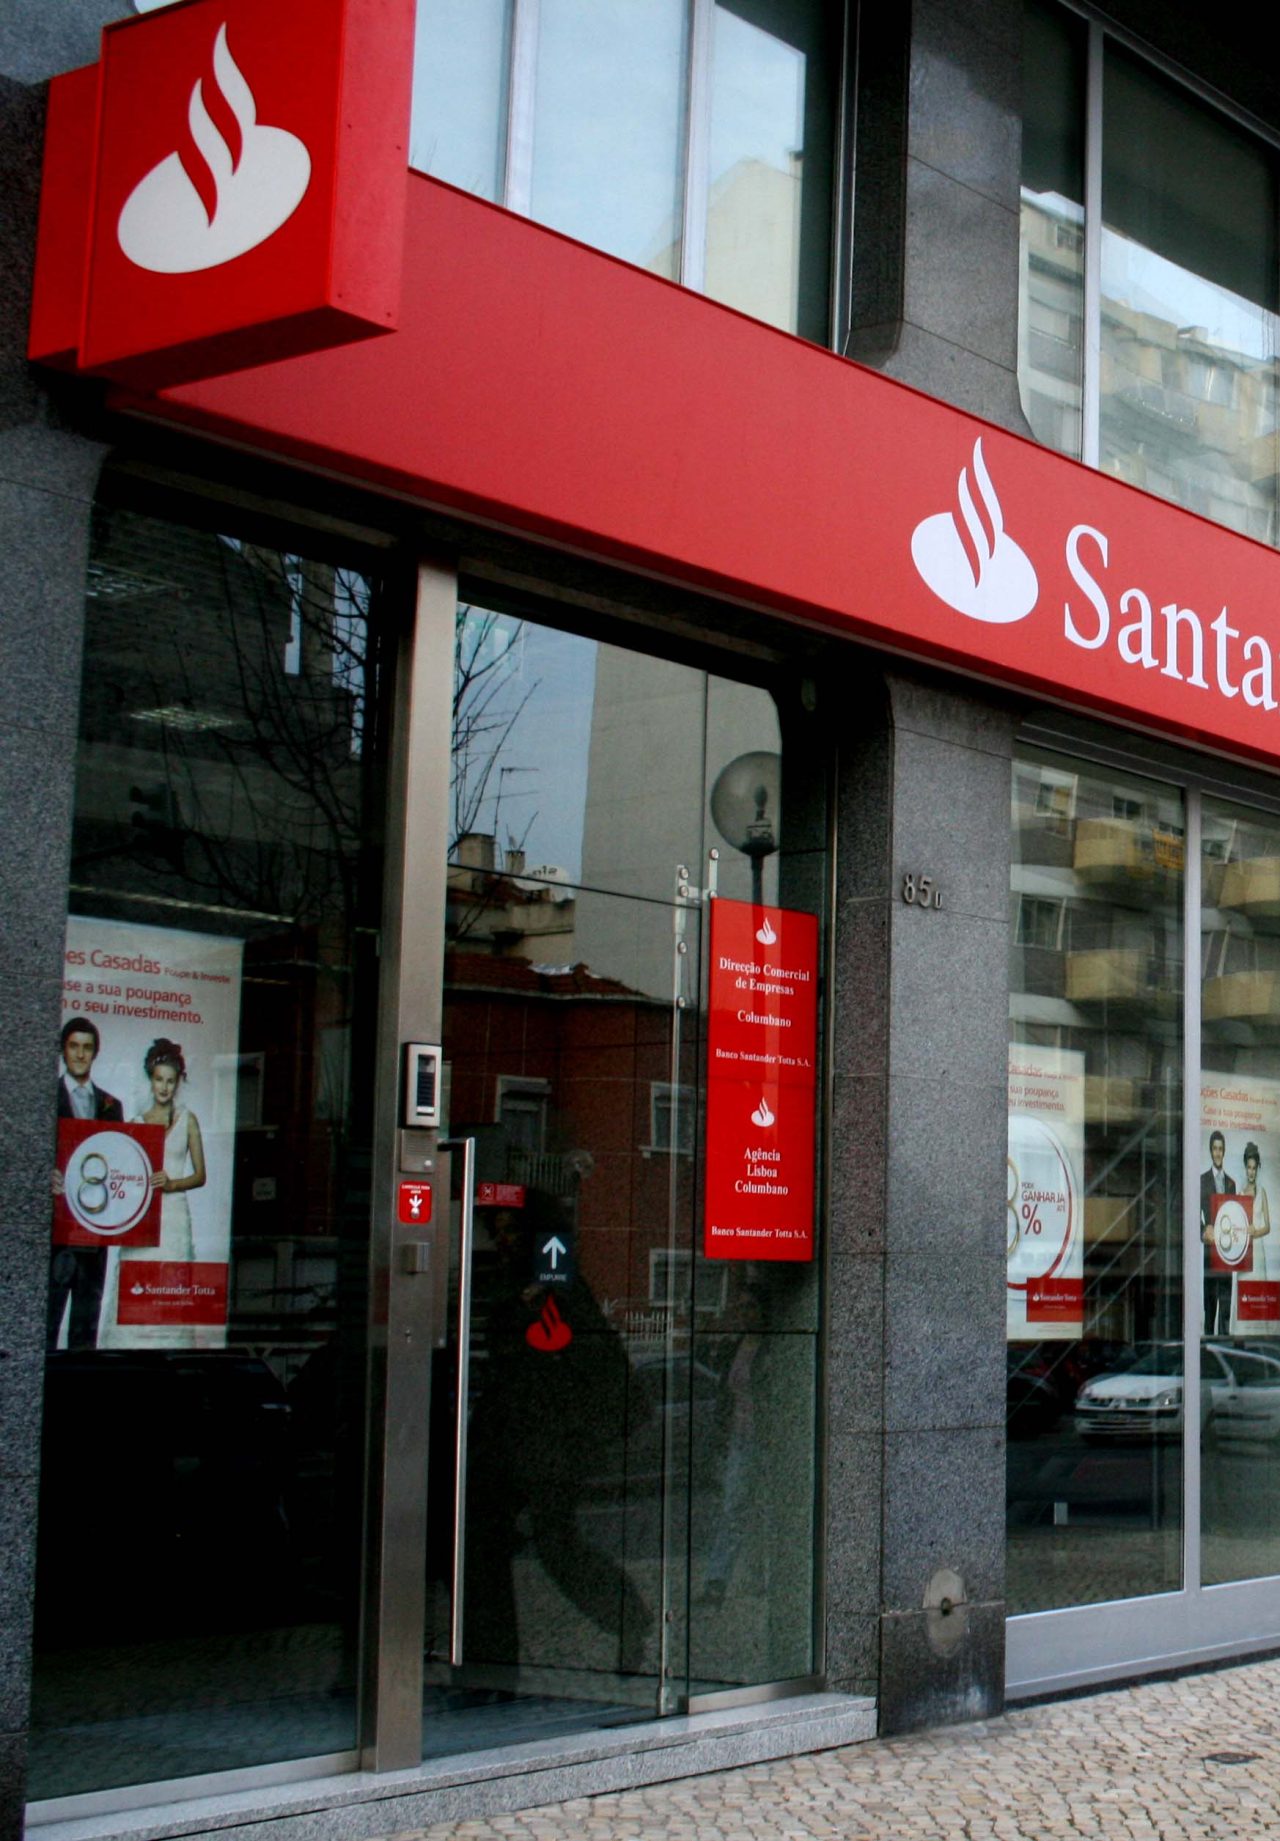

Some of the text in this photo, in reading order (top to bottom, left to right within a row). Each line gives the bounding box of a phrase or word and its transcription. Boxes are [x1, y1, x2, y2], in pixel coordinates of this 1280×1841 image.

[65, 950, 86, 966] es
[90, 949, 161, 975] Casadas
[719, 957, 810, 981] Direcção Comercial
[86, 982, 94, 994] a
[98, 984, 122, 997] sua
[126, 986, 192, 1007] poupança
[736, 977, 794, 995] de Empresas
[72, 1000, 80, 1010] o
[85, 1002, 109, 1014] seu
[113, 1000, 204, 1025] investimento.
[738, 1010, 791, 1027] Columbano
[716, 1048, 811, 1067] Banco Santander Totta S.A.
[744, 1147, 781, 1163] Agência
[747, 1164, 778, 1178] Lisboa
[735, 1180, 788, 1195] Columbano
[711, 1226, 808, 1239] Banco Santander Totta S.A.
[145, 1284, 216, 1296] Santander Totta
